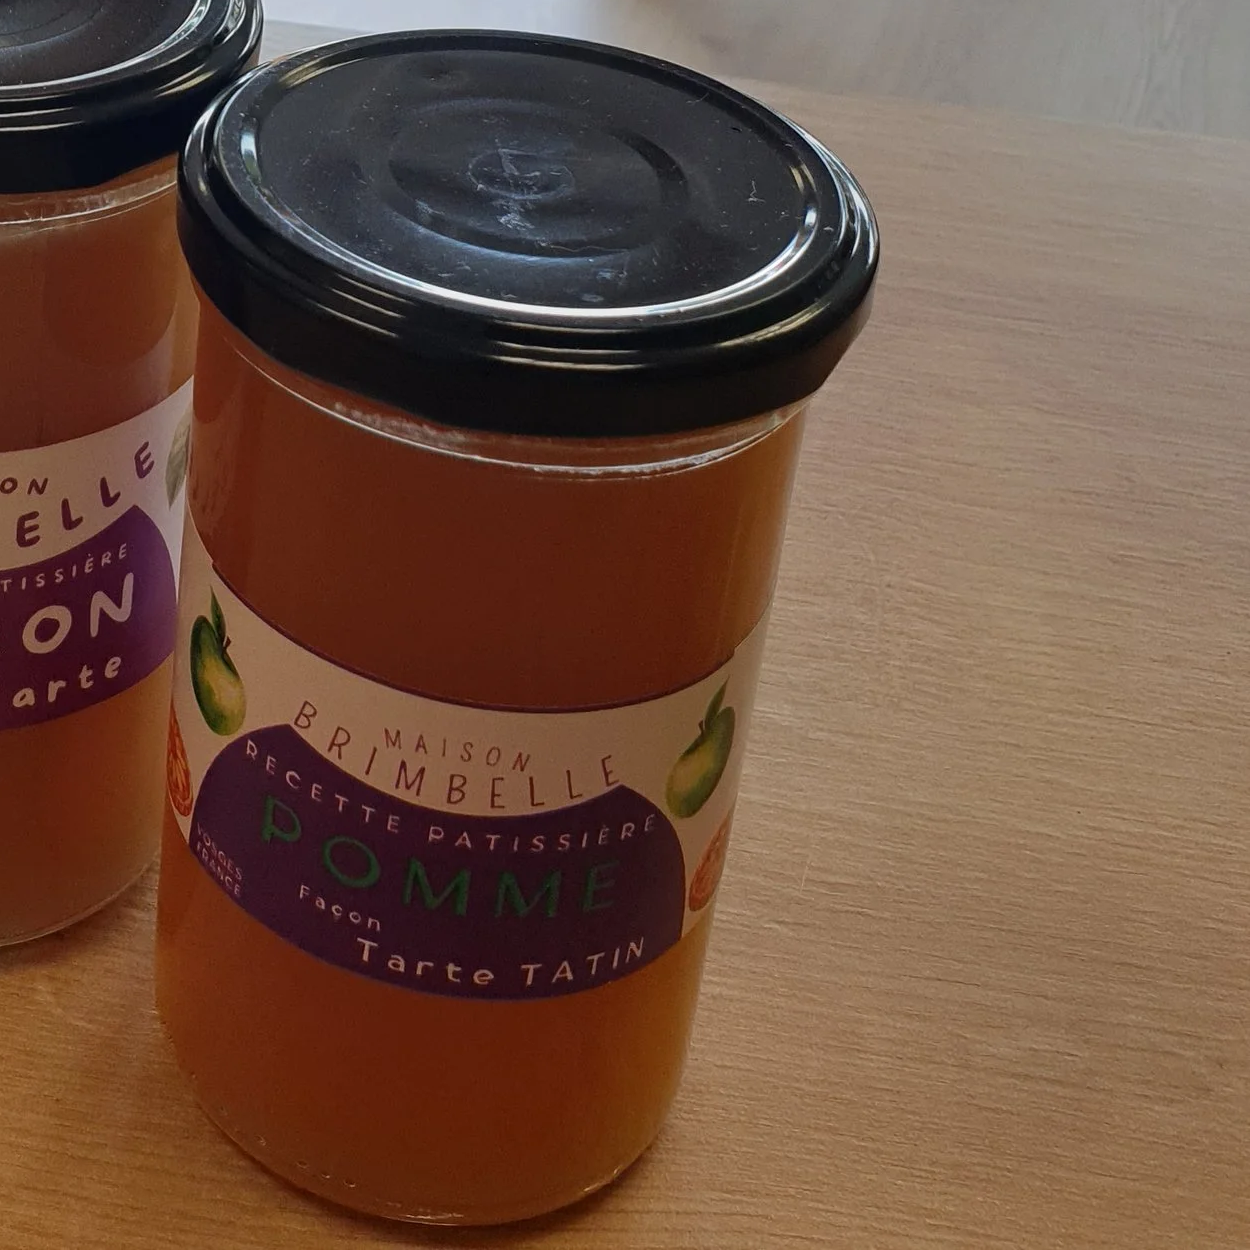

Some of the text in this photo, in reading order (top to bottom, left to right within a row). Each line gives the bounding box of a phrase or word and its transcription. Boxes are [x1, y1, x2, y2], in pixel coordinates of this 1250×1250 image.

[294, 701, 620, 808] BRIMBELLE
[384, 728, 530, 773] MAISON
[247, 740, 655, 851] RECETTE PATISSIÈRE
[261, 795, 621, 918] POMME
[299, 885, 382, 931] Façon
[356, 937, 644, 987] Tarte TATIN
